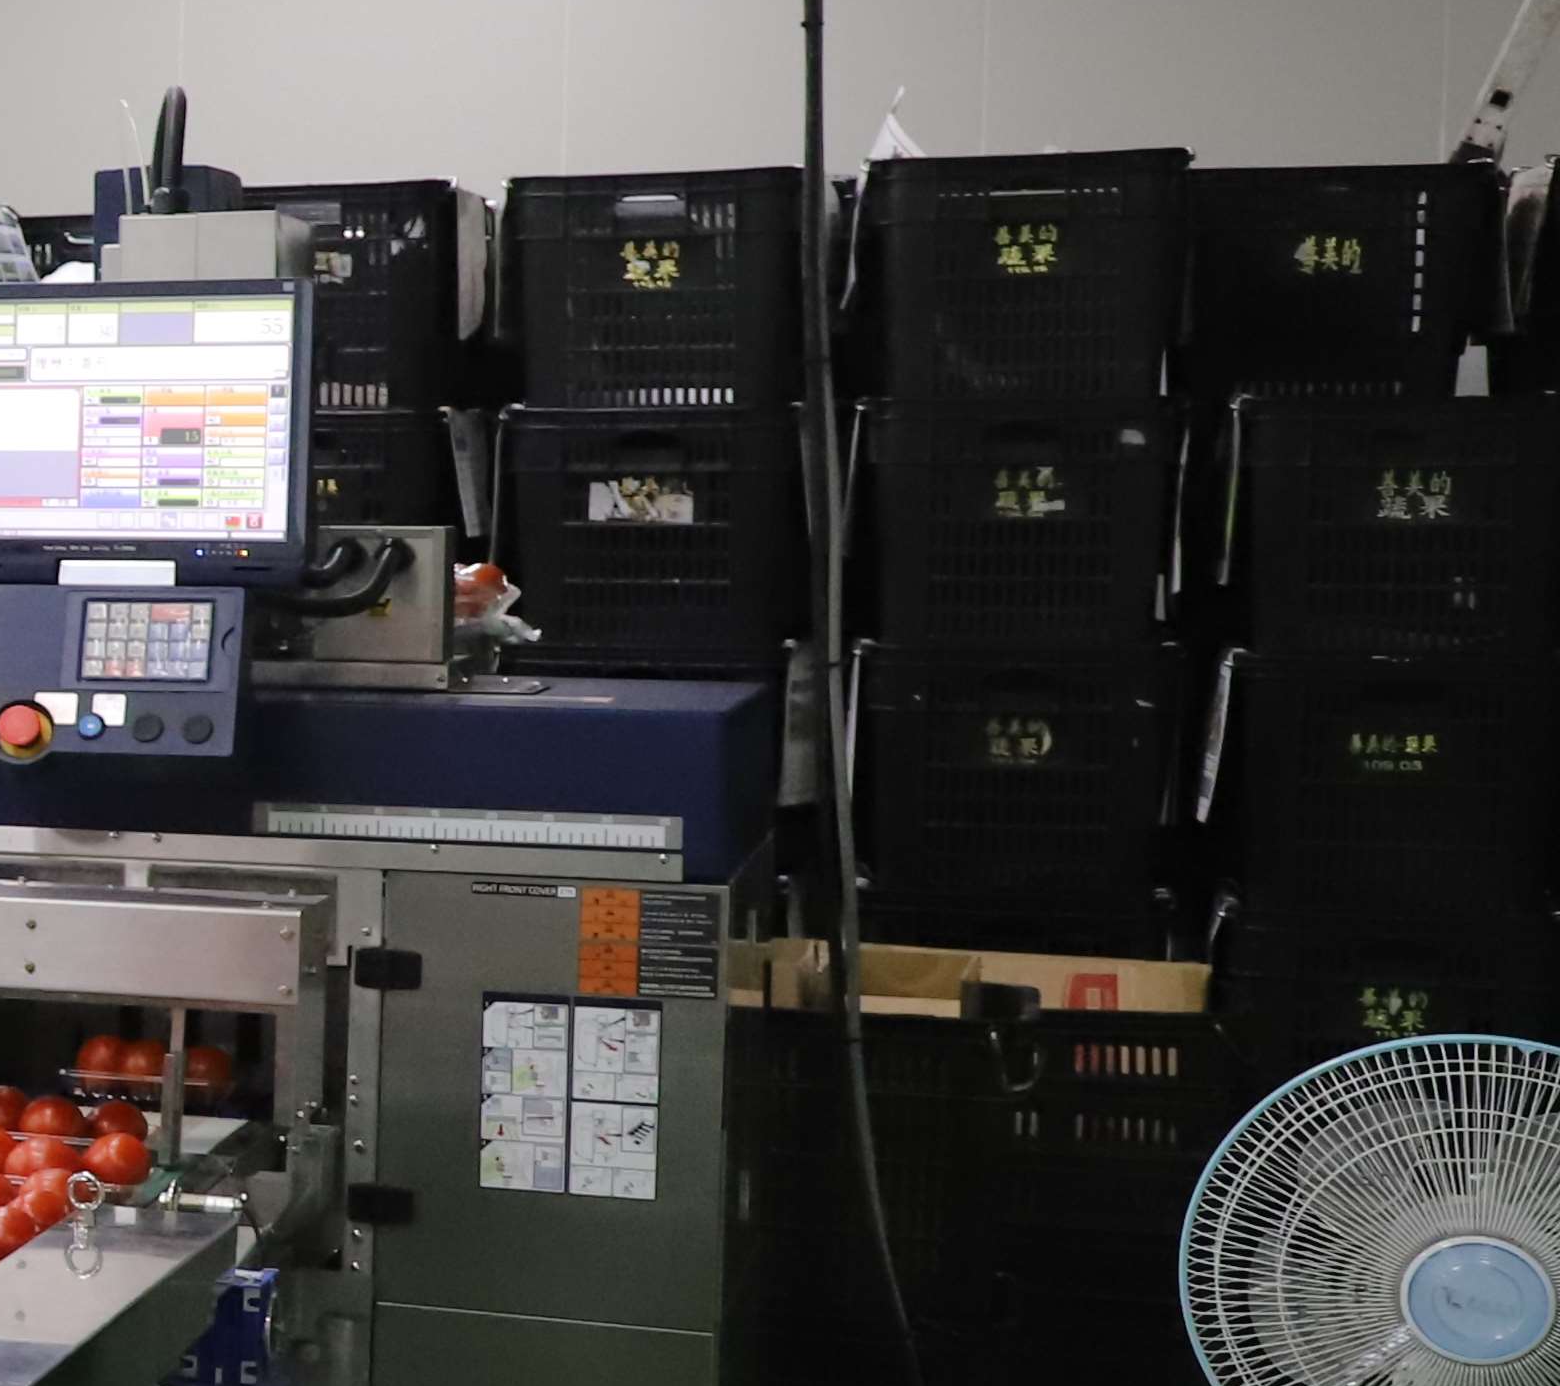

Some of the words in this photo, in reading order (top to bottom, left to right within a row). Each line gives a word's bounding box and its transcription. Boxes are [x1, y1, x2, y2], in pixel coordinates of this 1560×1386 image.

[1375, 469, 1451, 496] 善美的
[1375, 496, 1450, 519] 蔬果
